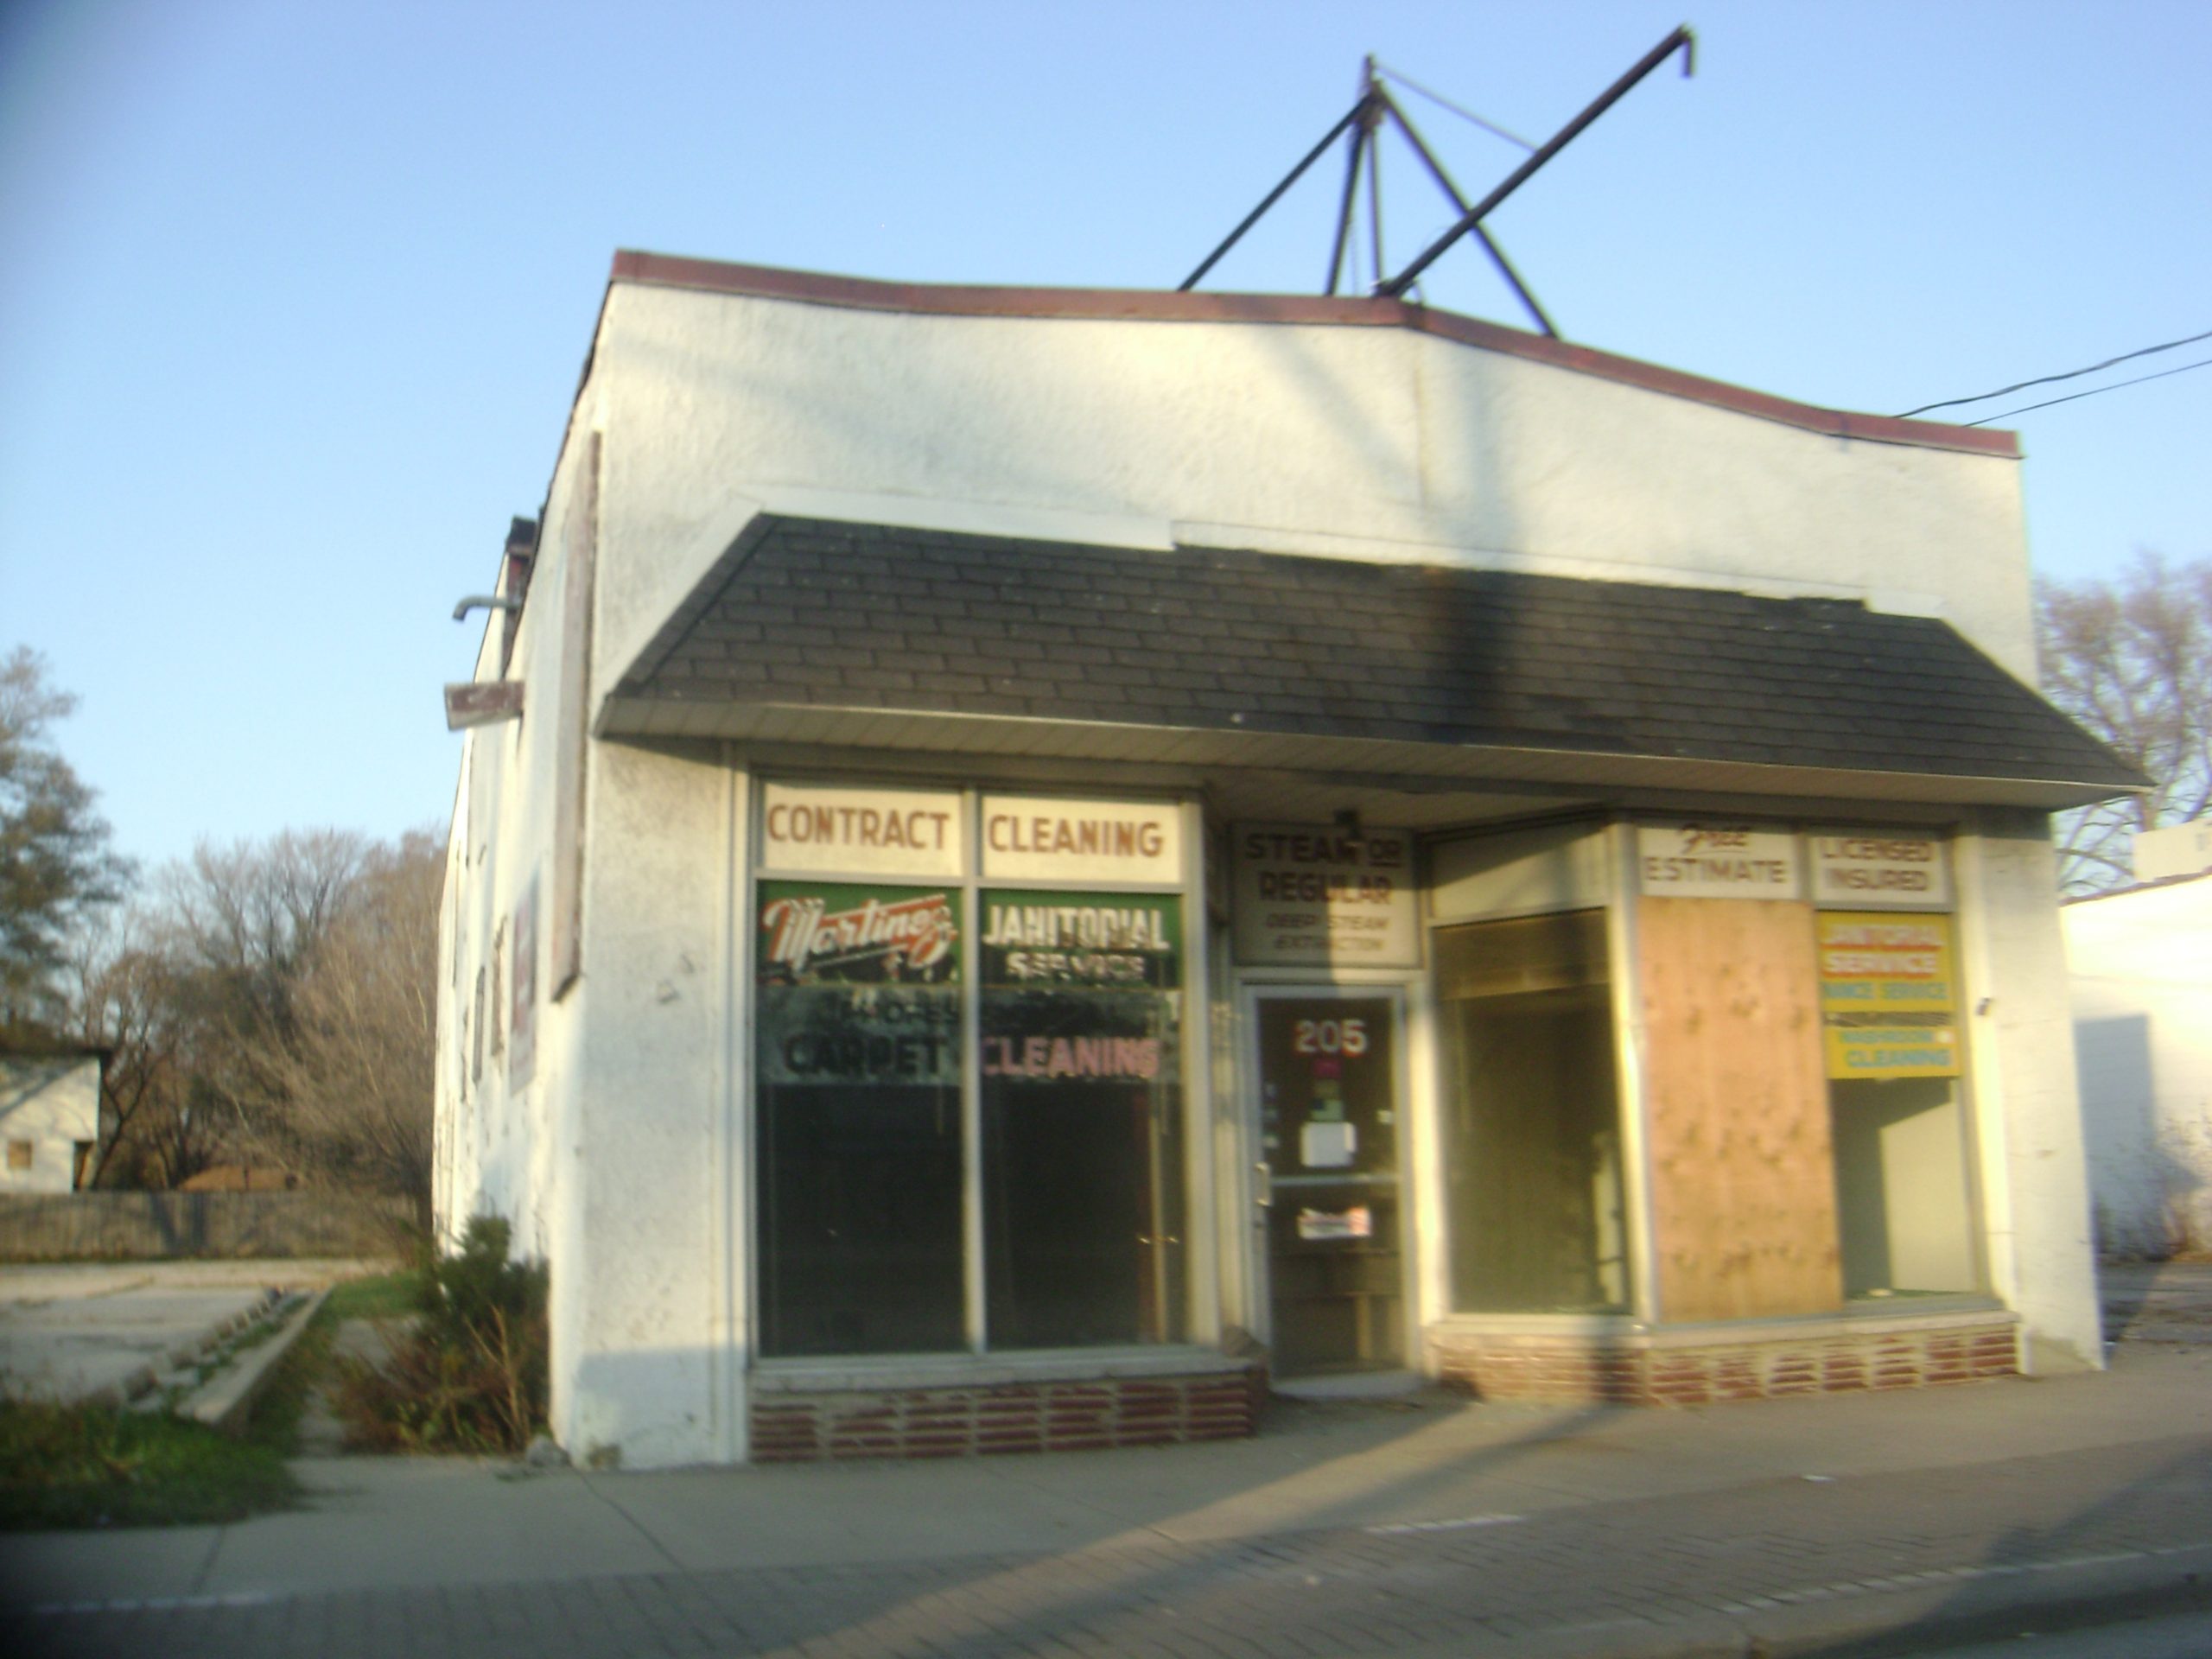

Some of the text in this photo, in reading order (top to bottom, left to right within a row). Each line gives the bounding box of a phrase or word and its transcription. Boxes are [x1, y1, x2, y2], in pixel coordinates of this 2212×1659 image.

[768, 804, 1164, 858] CONTRACT CLEANING
[1822, 837, 1933, 863] LICENSED
[1644, 856, 1787, 884] ESTIMATE
[1825, 867, 1928, 892] INSURED
[1258, 871, 1394, 906] REGULAR
[982, 906, 1170, 950] JANITORIAL
[1295, 1020, 1367, 1057] 205
[982, 1037, 1160, 1077] CLEANING
